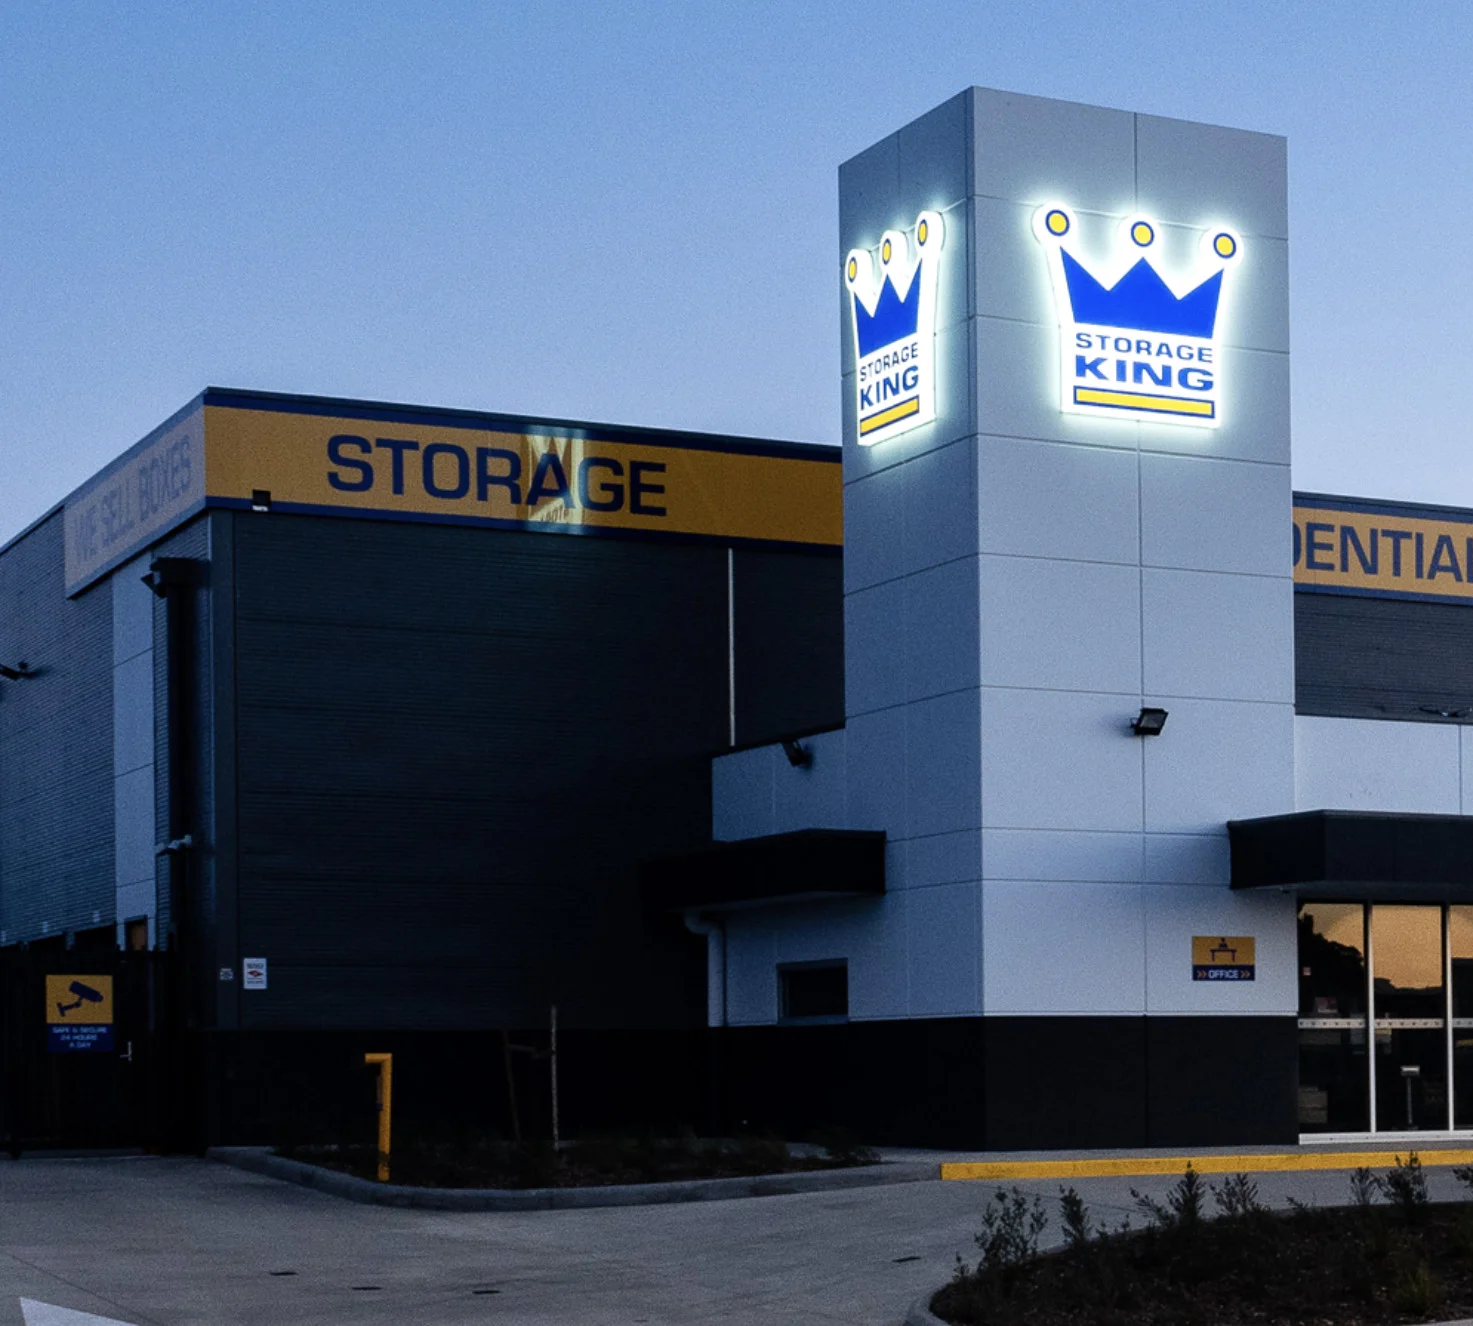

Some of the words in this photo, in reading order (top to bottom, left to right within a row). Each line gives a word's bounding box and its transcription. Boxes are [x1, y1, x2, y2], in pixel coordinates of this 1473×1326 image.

[859, 342, 919, 382] STORAGE
[1075, 332, 1213, 364] STORAGE
[859, 366, 919, 411] KING
[1074, 355, 1215, 392] KING
[101, 478, 134, 548] SELL
[139, 434, 192, 521] BOXES
[326, 434, 668, 517] STORAGE
[1208, 969, 1239, 979] OFFICE
